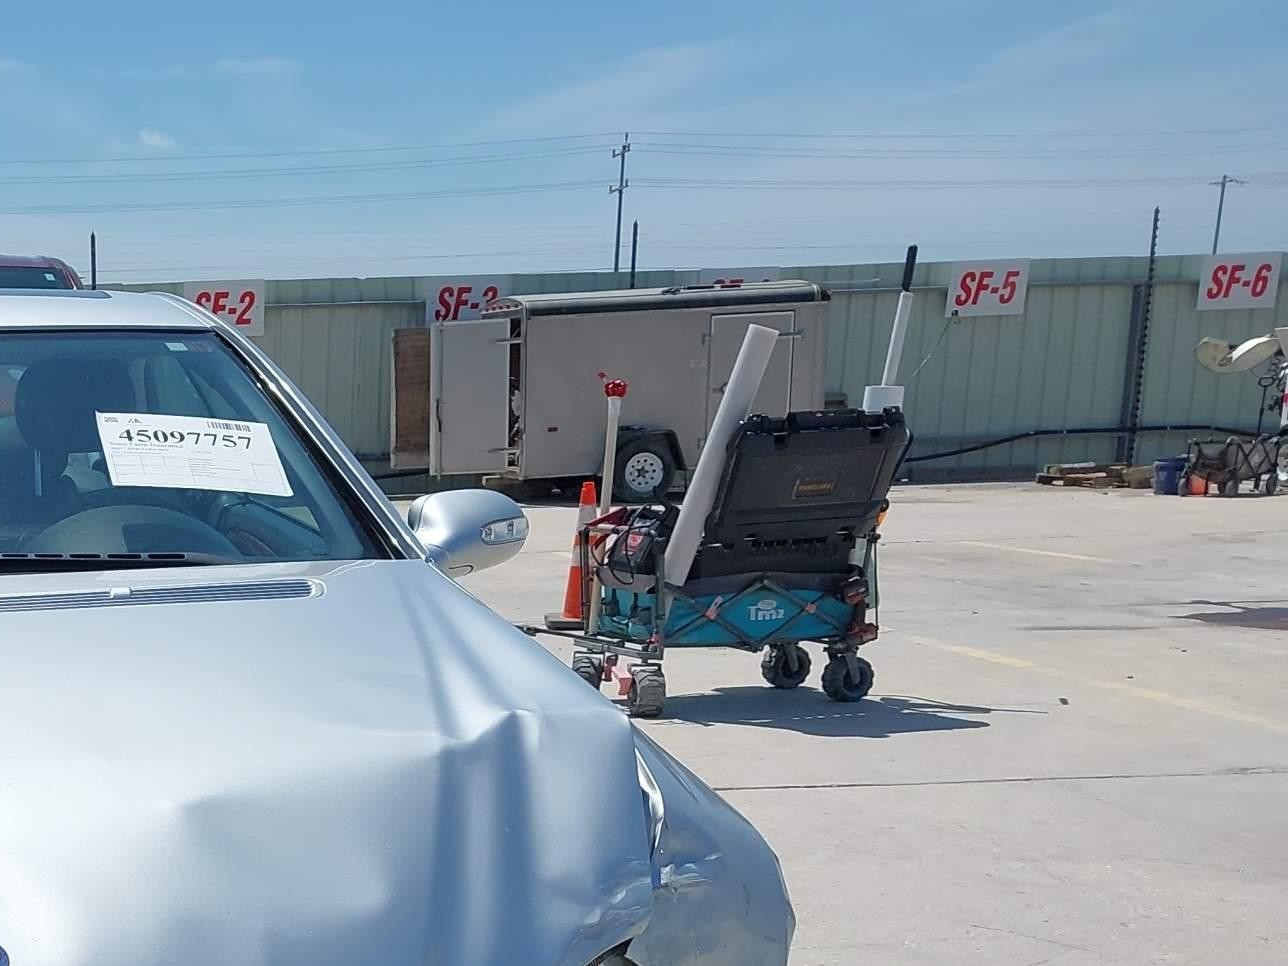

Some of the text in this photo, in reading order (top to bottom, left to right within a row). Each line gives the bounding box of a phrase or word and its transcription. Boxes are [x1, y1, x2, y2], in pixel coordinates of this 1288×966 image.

[954, 270, 1021, 306] SF-5
[1206, 263, 1273, 300] SF-6
[118, 428, 252, 450] 45097757
